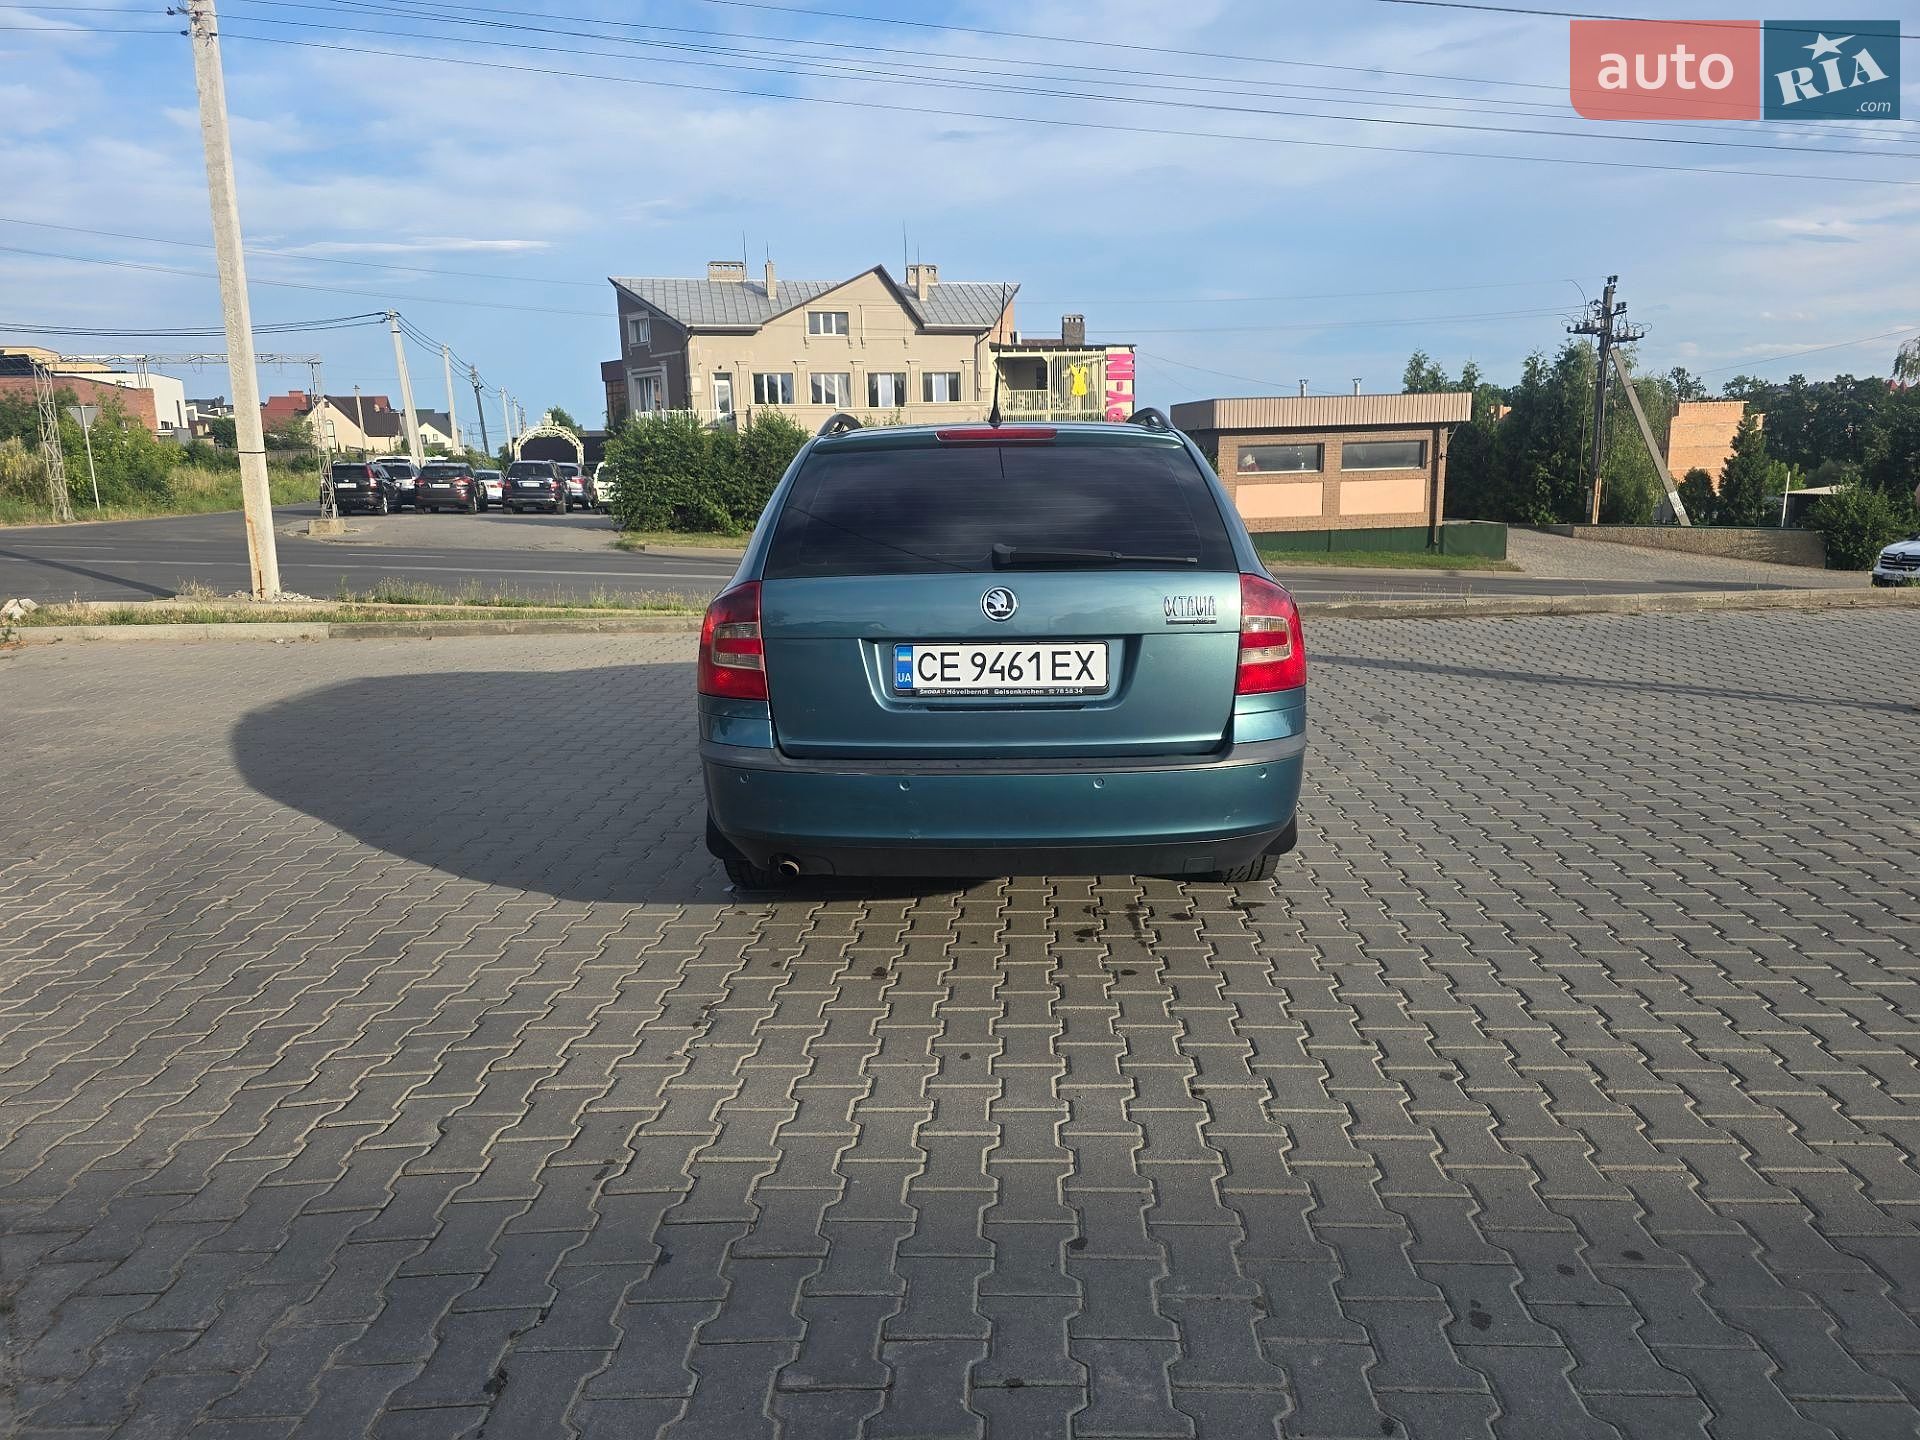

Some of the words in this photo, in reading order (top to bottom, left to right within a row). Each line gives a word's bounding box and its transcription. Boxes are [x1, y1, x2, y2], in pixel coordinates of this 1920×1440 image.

[1163, 595, 1216, 616] OCTAVIA
[917, 651, 961, 682] CE
[970, 651, 1041, 681] 9461
[1051, 650, 1096, 681] EX
[898, 673, 912, 683] UA
